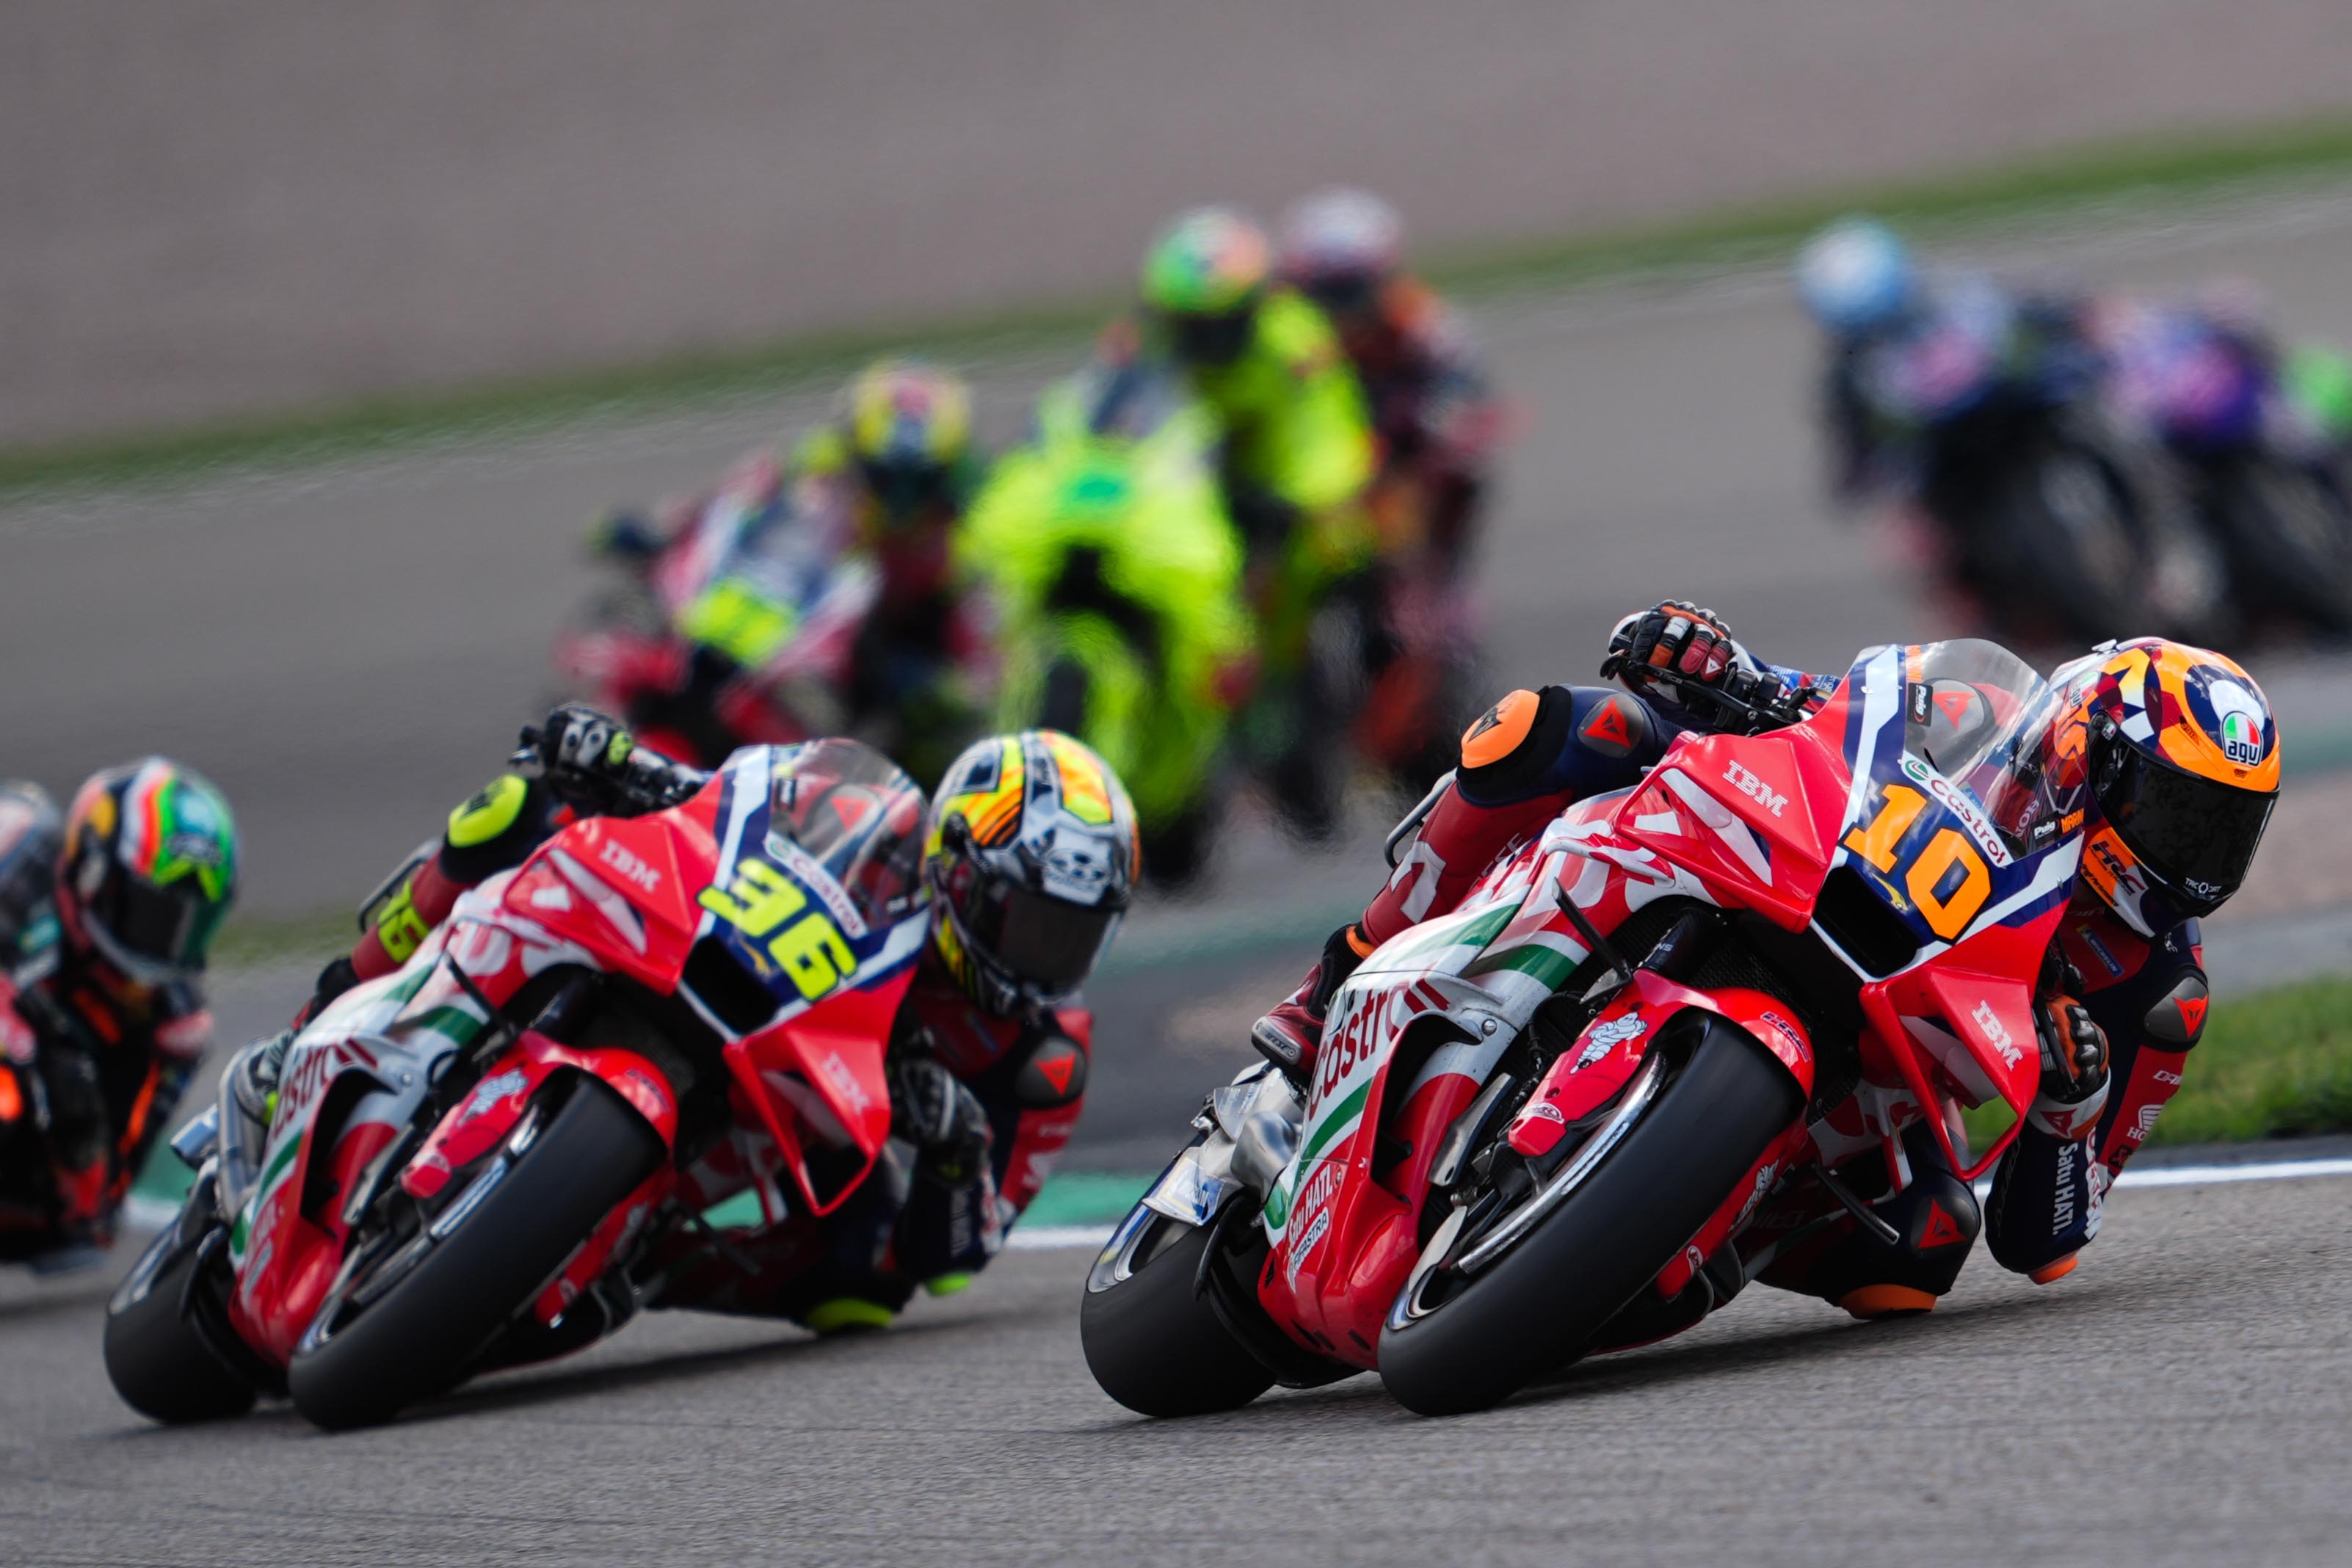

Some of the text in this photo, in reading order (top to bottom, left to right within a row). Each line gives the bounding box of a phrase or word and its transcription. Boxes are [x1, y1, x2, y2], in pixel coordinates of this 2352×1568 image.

[1914, 683, 1927, 716] Puig
[2228, 739, 2258, 763] agv
[1722, 759, 1789, 819] IBM
[1930, 779, 2007, 864] Castrol
[2033, 820, 2056, 838] Puig
[599, 838, 661, 893] IBM
[1843, 783, 1992, 940] 10
[2090, 840, 2146, 894] HRC
[793, 856, 860, 932] Castrol
[697, 857, 857, 1001] 36
[1971, 999, 2024, 1072] IBM
[1304, 1163, 1333, 1224] HATI.
[2052, 1142, 2079, 1235] Satu HATI.
